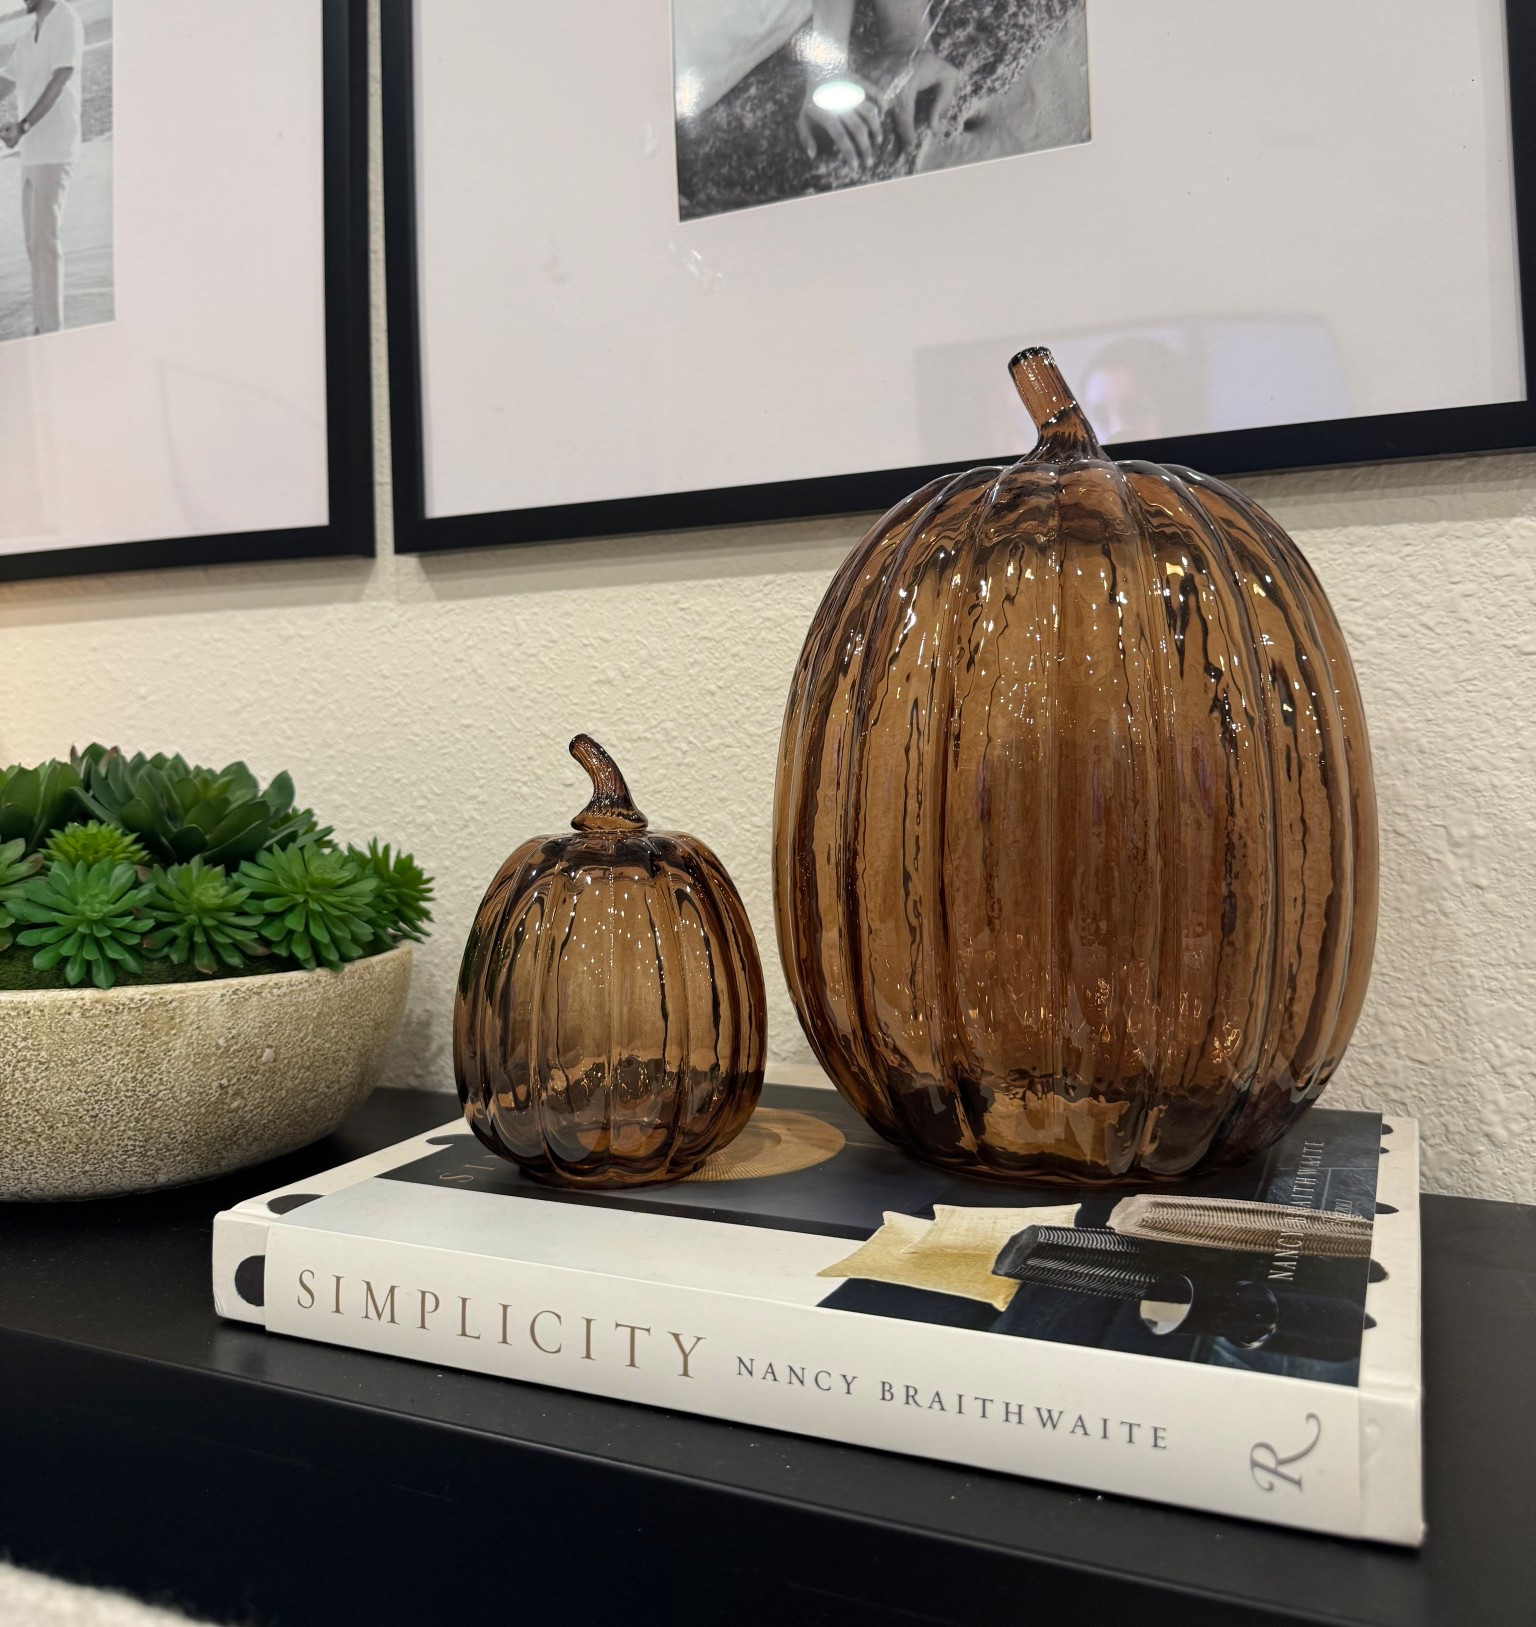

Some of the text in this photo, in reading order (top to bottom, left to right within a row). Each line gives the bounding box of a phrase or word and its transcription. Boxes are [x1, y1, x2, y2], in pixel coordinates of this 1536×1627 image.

[1267, 1229, 1304, 1281] NANCY
[297, 1269, 706, 1379] SIMPLICITY
[736, 1355, 1168, 1450] NANCY BRAITHWAITE
